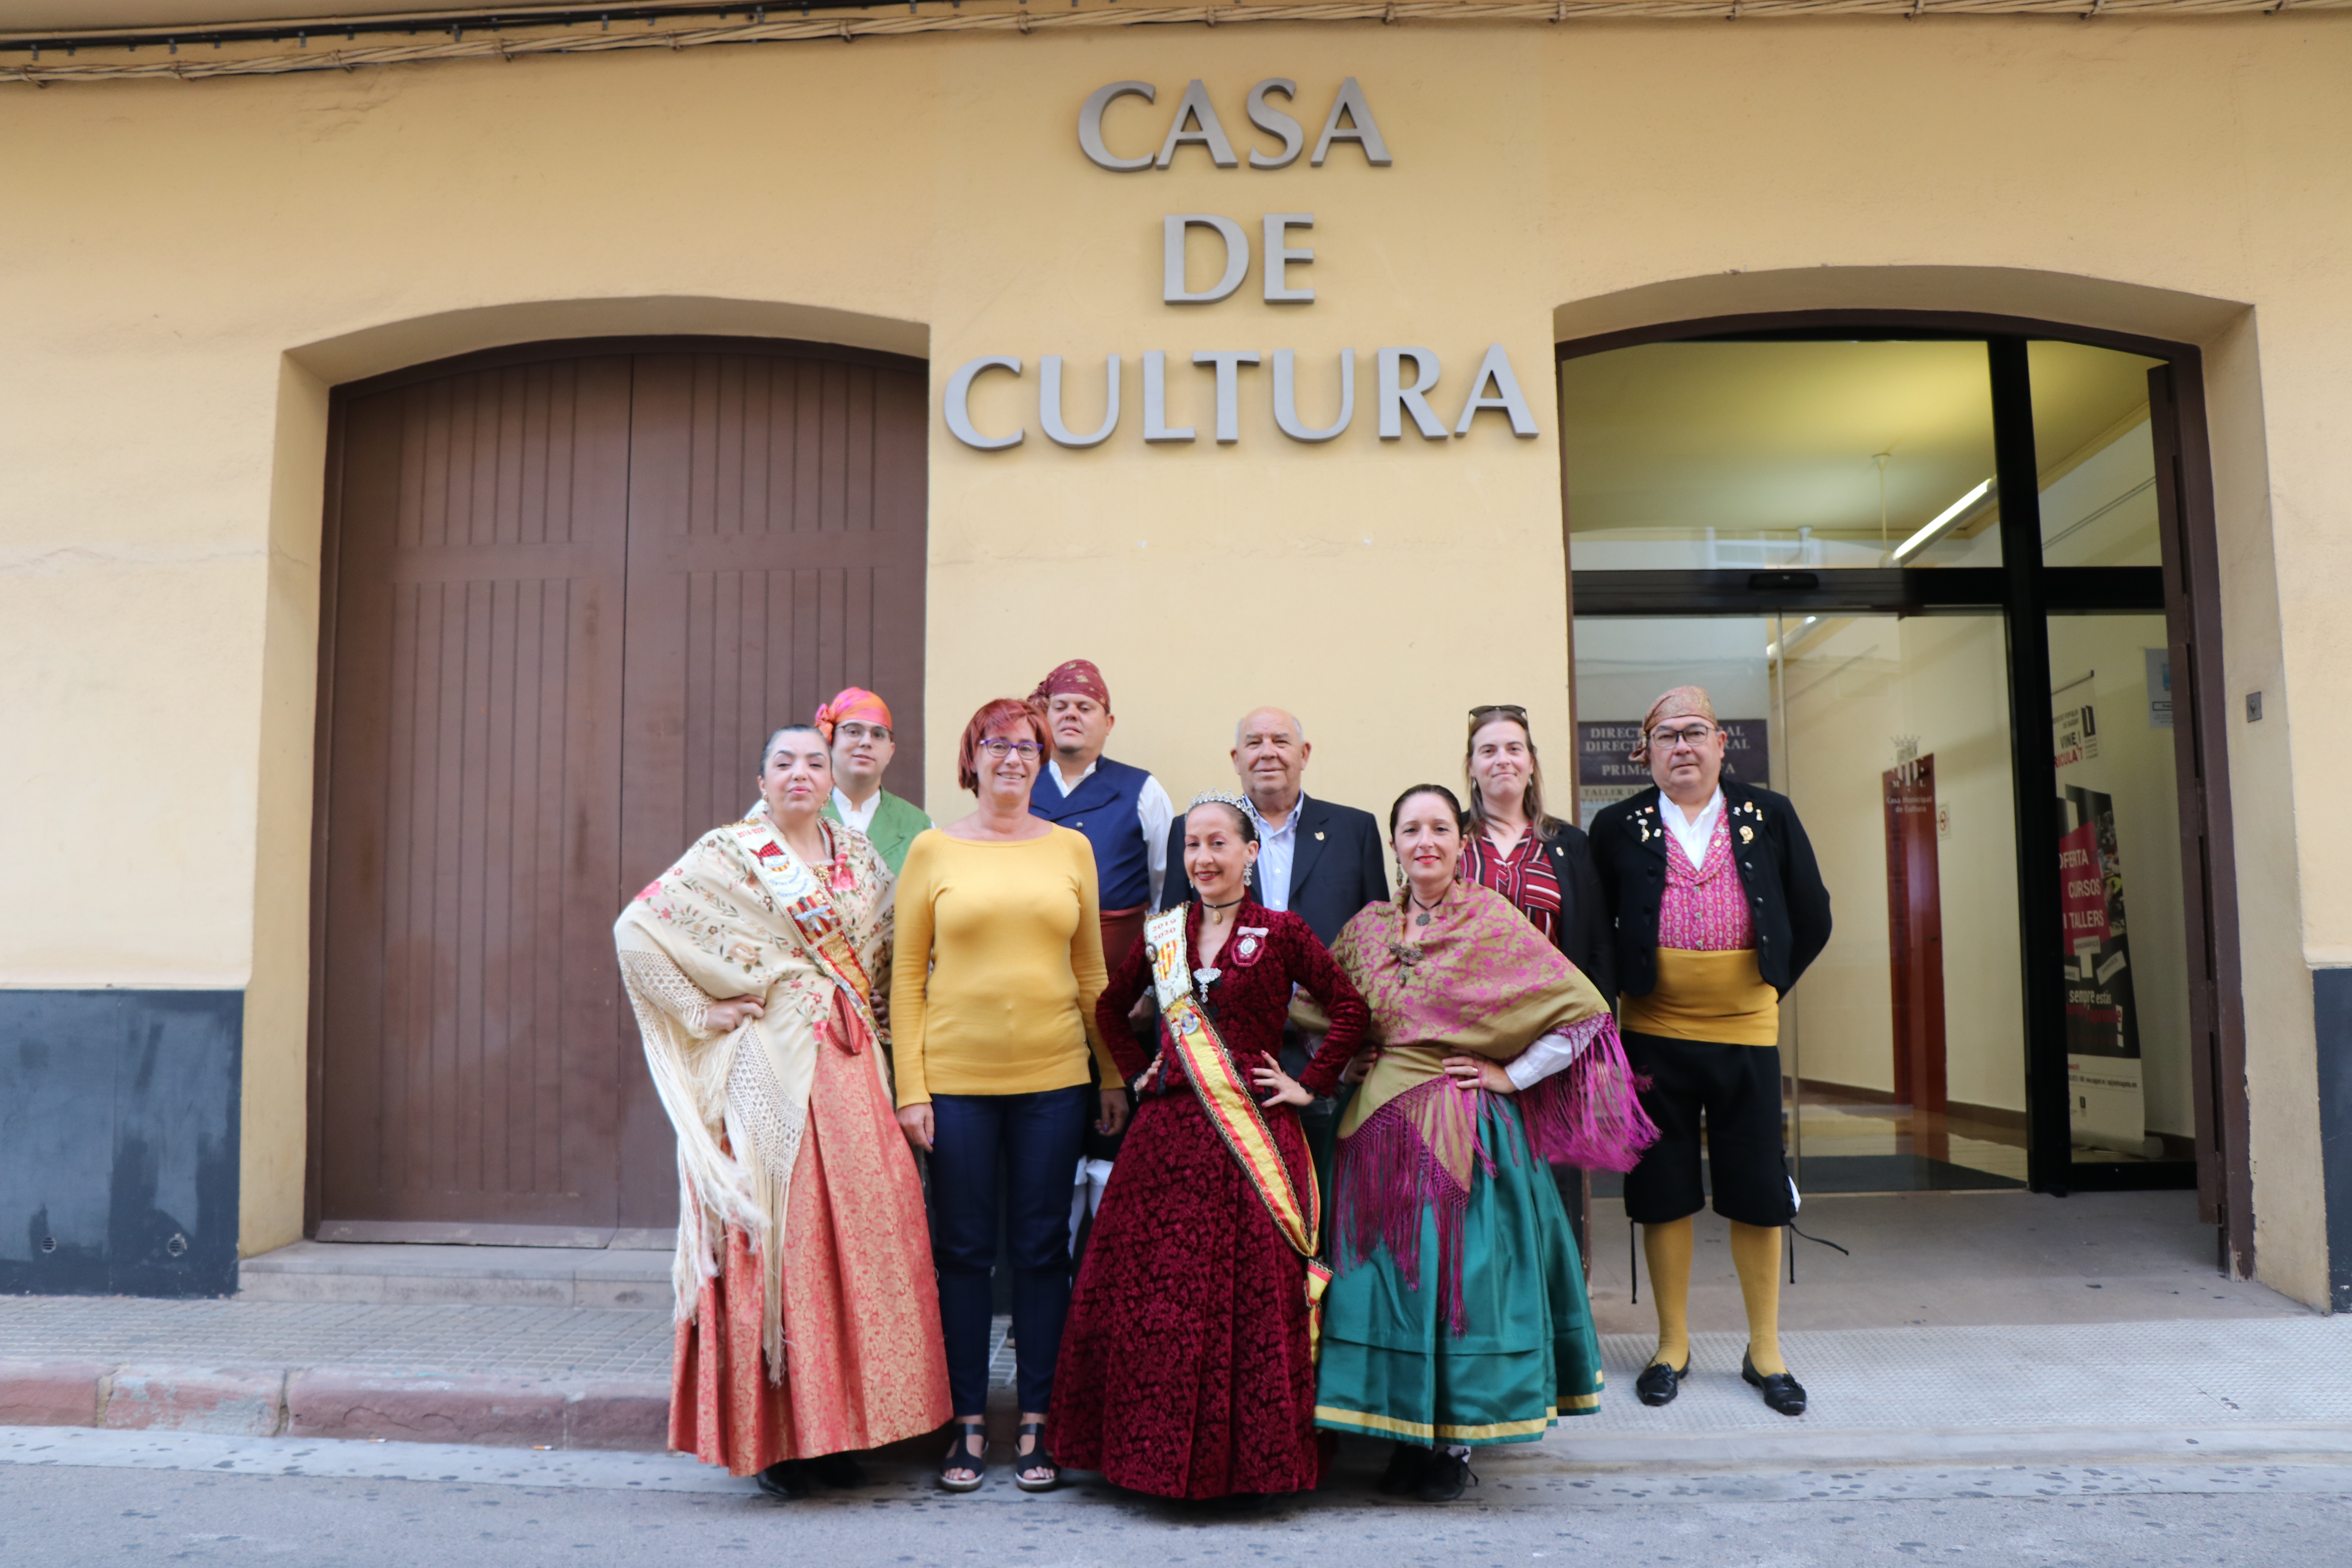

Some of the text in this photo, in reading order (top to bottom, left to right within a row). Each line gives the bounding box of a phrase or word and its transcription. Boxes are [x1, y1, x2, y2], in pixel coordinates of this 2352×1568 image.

[1078, 77, 1392, 172] CASA
[1164, 213, 1315, 305] DE
[944, 344, 1539, 451] CULTURA
[1591, 727, 1641, 738] DIRECT
[1586, 740, 1637, 751] DIRECT
[2068, 878, 2101, 898] CURSOS
[1152, 919, 1176, 932] 2019
[2069, 909, 2104, 929] TALLERS
[1153, 927, 1176, 942] 2020
